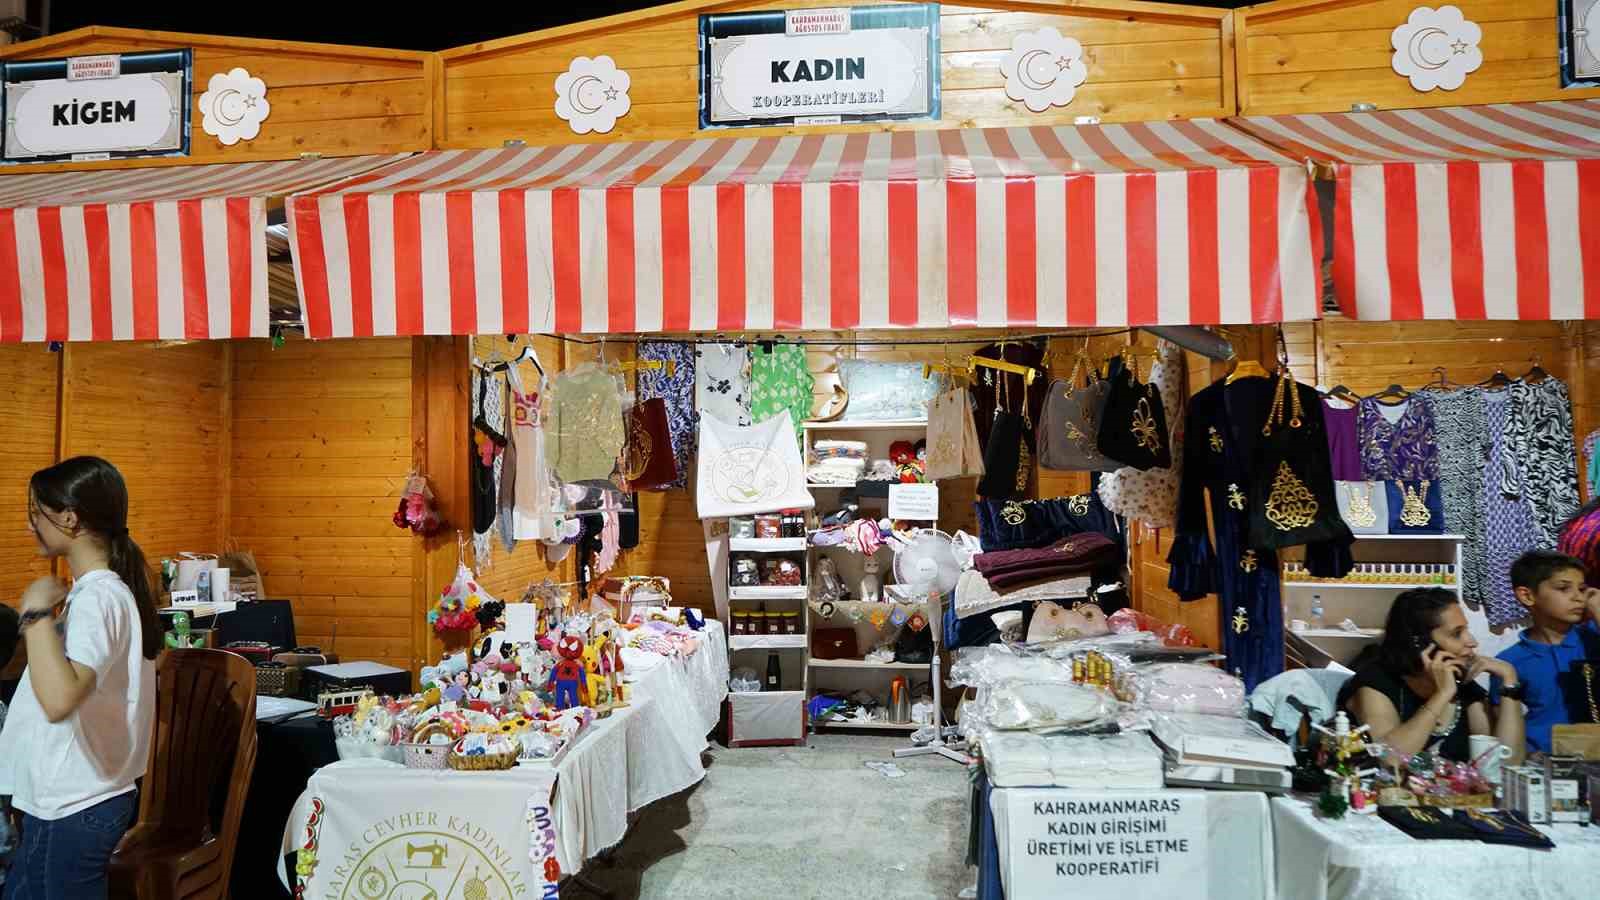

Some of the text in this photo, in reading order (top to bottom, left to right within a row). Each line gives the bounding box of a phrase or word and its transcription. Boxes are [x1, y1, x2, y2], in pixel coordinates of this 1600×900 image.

[771, 57, 865, 83] KADIN
[751, 88, 885, 108] KOOPERATİFLERİ
[52, 98, 136, 126] KİGEM
[1033, 799, 1181, 815] KAHRAMANMARAŞ
[363, 811, 438, 844] CEVHER
[1047, 818, 1167, 837] KADIN GİRİŞİMİ
[1027, 838, 1189, 857] ÜRETİMİ VE İŞLETME
[1056, 857, 1160, 876] KOOPERATİFİ
